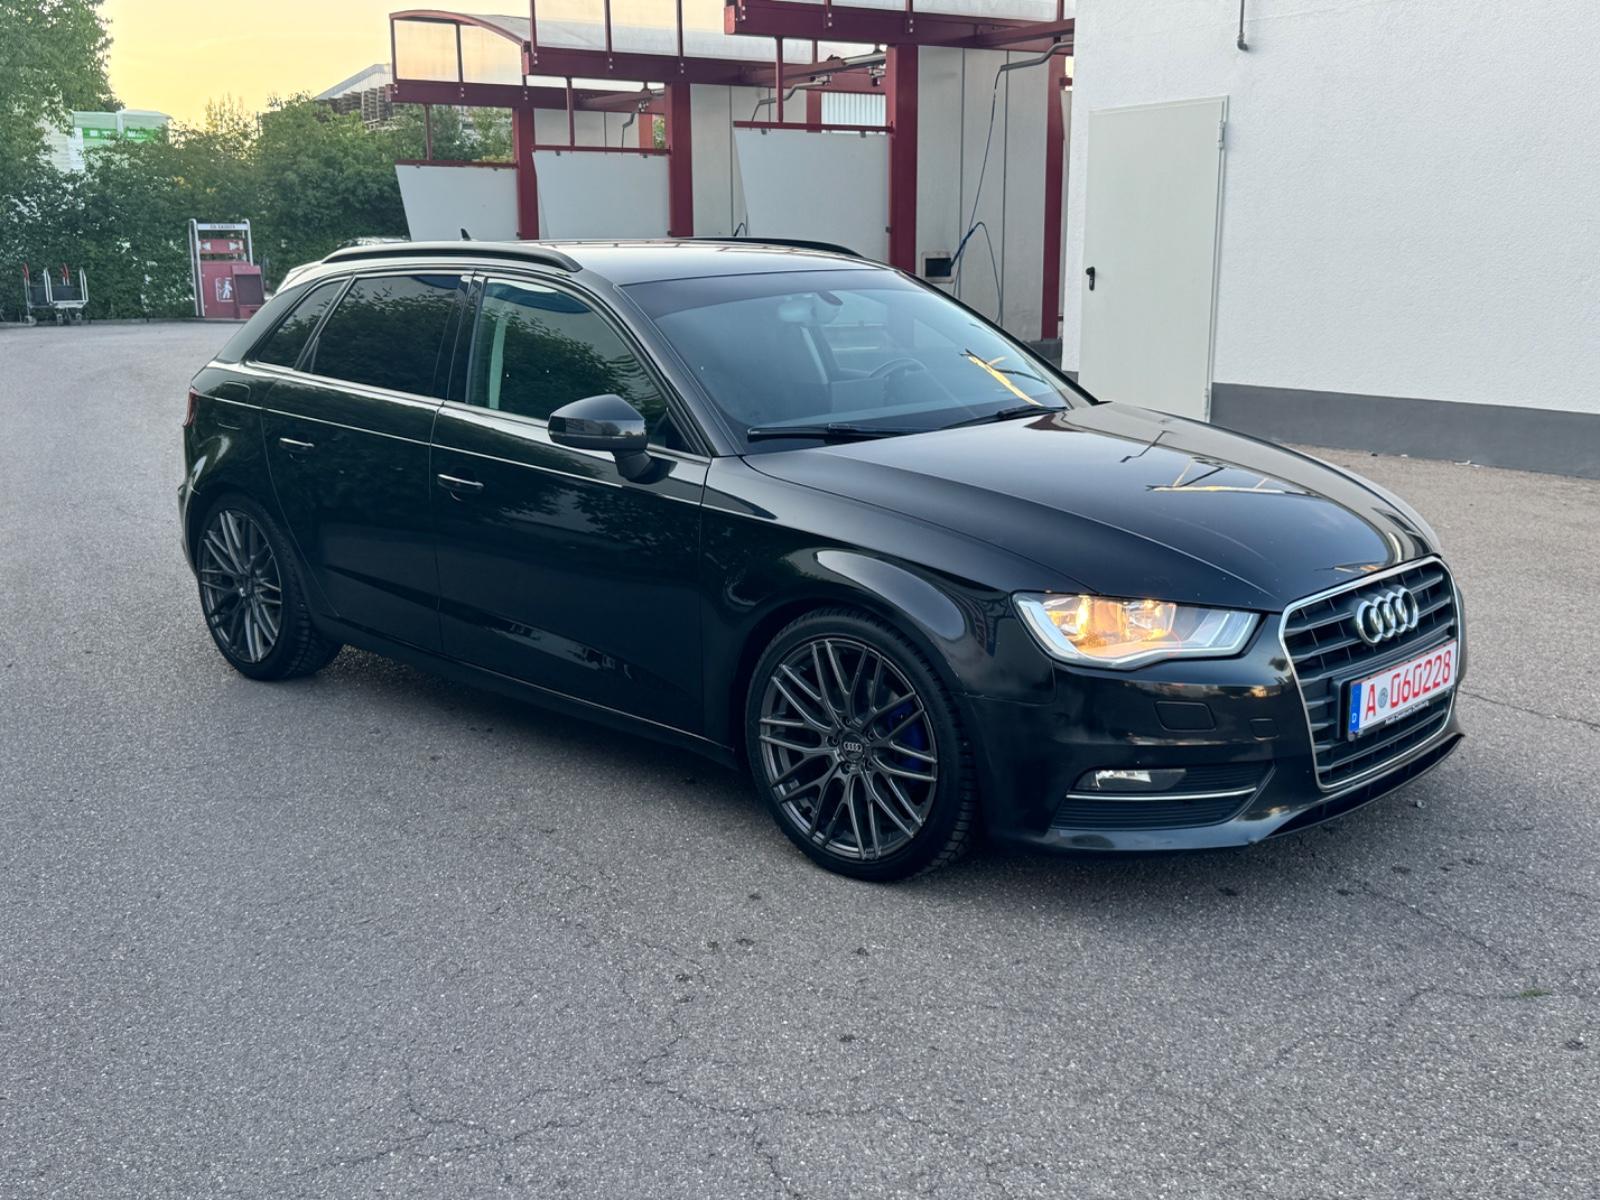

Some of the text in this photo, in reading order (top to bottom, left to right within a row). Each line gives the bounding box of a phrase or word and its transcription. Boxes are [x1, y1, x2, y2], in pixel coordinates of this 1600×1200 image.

[1365, 683, 1376, 721] A
[1390, 650, 1451, 708] 060228
[1351, 712, 1358, 724] D
